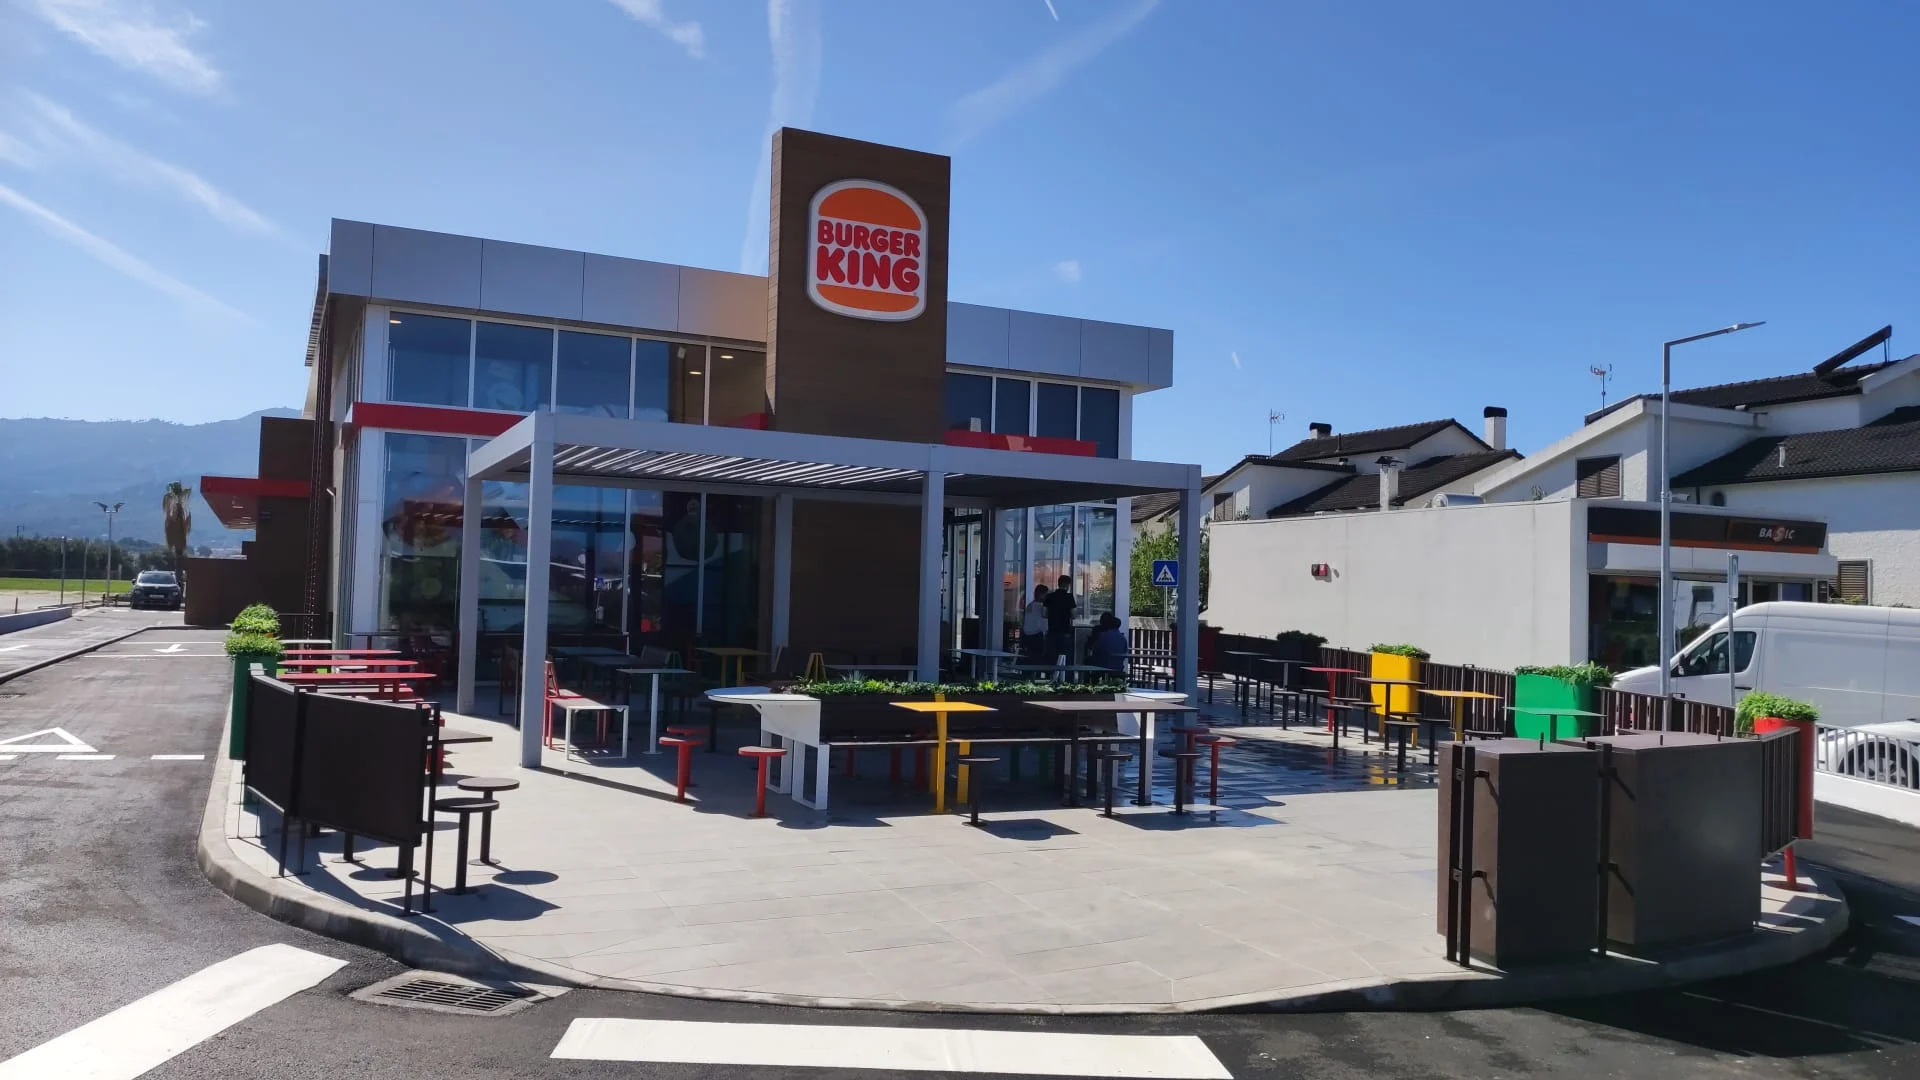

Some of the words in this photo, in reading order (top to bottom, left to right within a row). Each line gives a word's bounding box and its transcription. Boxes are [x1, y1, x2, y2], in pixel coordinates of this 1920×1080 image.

[818, 220, 920, 257] BURGER
[817, 245, 920, 292] KING
[1759, 526, 1795, 542] BASIC
